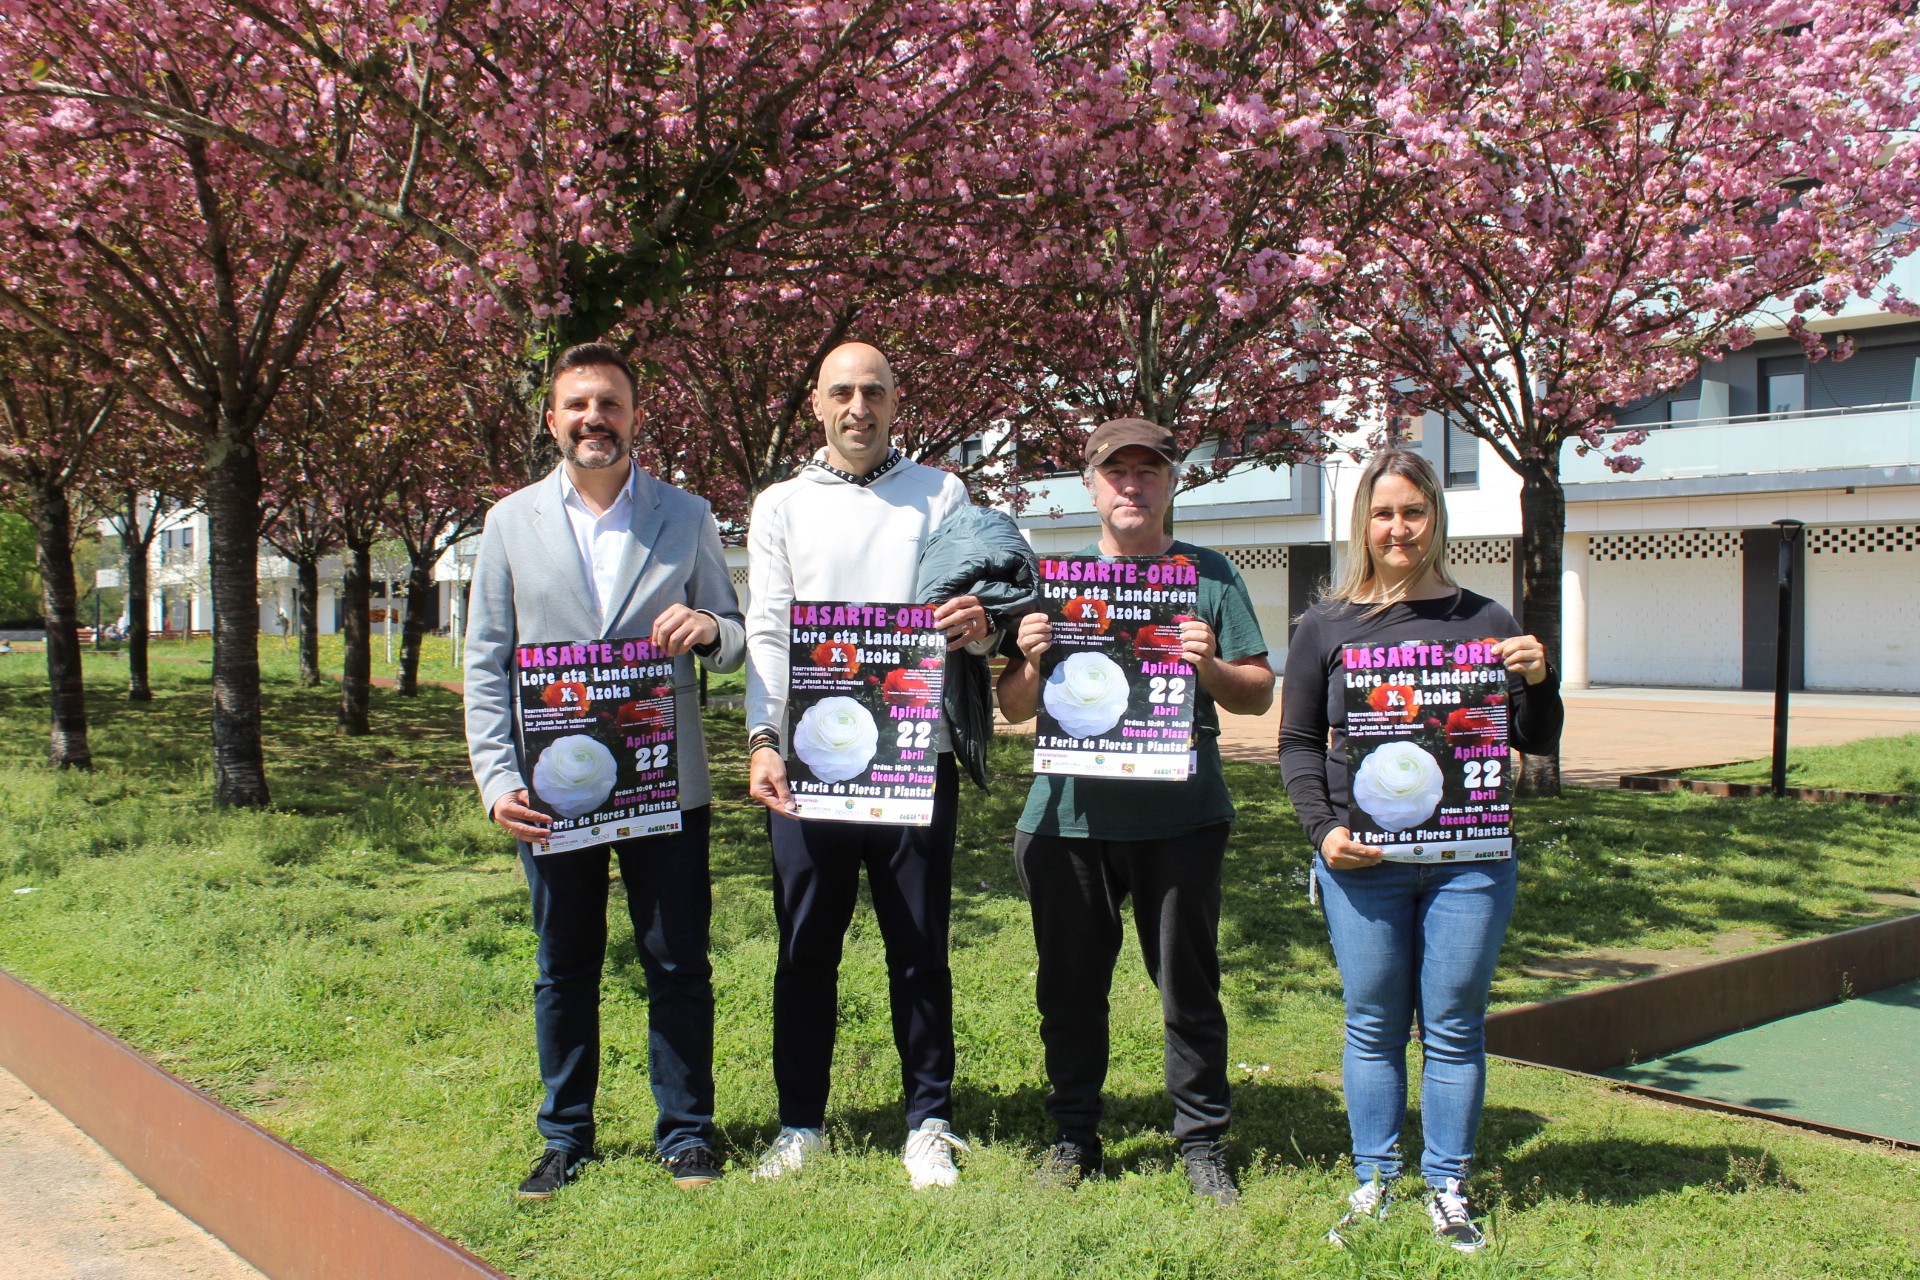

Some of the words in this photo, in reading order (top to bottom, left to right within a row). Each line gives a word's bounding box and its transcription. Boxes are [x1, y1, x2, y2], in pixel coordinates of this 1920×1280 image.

[1045, 560, 1197, 585] LASARTE-ORIA
[1044, 583, 1077, 598] Lore
[1084, 586, 1108, 600] eta
[1116, 587, 1196, 603] Landareen
[792, 606, 937, 628] LASARTE-ORI
[1106, 605, 1151, 620] Azoka
[793, 629, 826, 644] Lore
[833, 630, 858, 644] eta
[866, 630, 945, 647] Landareen
[856, 648, 900, 664] Azoka
[1346, 644, 1499, 669] LASARTE-ORI
[521, 671, 555, 686] Lore
[562, 669, 587, 684] eta
[593, 663, 673, 682] Landareen
[1142, 661, 1193, 676] Apirilak
[1346, 673, 1381, 688] Lore
[1389, 671, 1414, 686] eta
[1422, 668, 1506, 685] Landareen
[586, 684, 630, 700] Azoka
[1149, 677, 1186, 704] 22
[1413, 689, 1461, 705] Azoka
[890, 705, 939, 720] Apirilak
[1153, 706, 1178, 716] Abril
[626, 730, 674, 749] Apirilak
[897, 721, 931, 748] 22
[1122, 727, 1158, 738] Okendo
[1162, 728, 1188, 739] Plaza
[1038, 736, 1046, 747] X
[1050, 736, 1078, 749] Feria
[1083, 738, 1095, 750] de
[1100, 739, 1132, 751] Flores
[1137, 742, 1143, 753] y
[1148, 740, 1187, 752] Plantas
[1454, 744, 1508, 760] Apirilak
[635, 744, 669, 772] 22
[900, 750, 924, 760] Abril
[641, 770, 664, 782] Abril
[871, 772, 905, 783] Okendo
[908, 772, 933, 783] Plaza
[1463, 760, 1501, 788] 22
[614, 793, 648, 806] Okendo
[651, 788, 676, 800] Plaza
[636, 784, 652, 793] 10:00
[790, 781, 798, 791] X
[802, 781, 829, 793] Feria
[833, 782, 845, 794] de
[849, 784, 880, 796] Flores
[884, 787, 890, 798] y
[894, 785, 932, 798] Plantas
[1470, 790, 1496, 801] Abril
[578, 815, 590, 826] de
[594, 810, 625, 824] Flores
[629, 808, 636, 817] y
[639, 801, 678, 812] Plantas
[1464, 805, 1483, 813] 10:00
[1491, 804, 1510, 812] 14:30
[1440, 814, 1477, 826] Okendo
[1482, 812, 1510, 823] Plaza
[1352, 832, 1360, 843] X
[1365, 830, 1394, 843] Feria
[1400, 830, 1412, 841] de
[1416, 828, 1451, 840] Flores
[1456, 830, 1463, 840] y
[1467, 825, 1509, 837] Plantas
